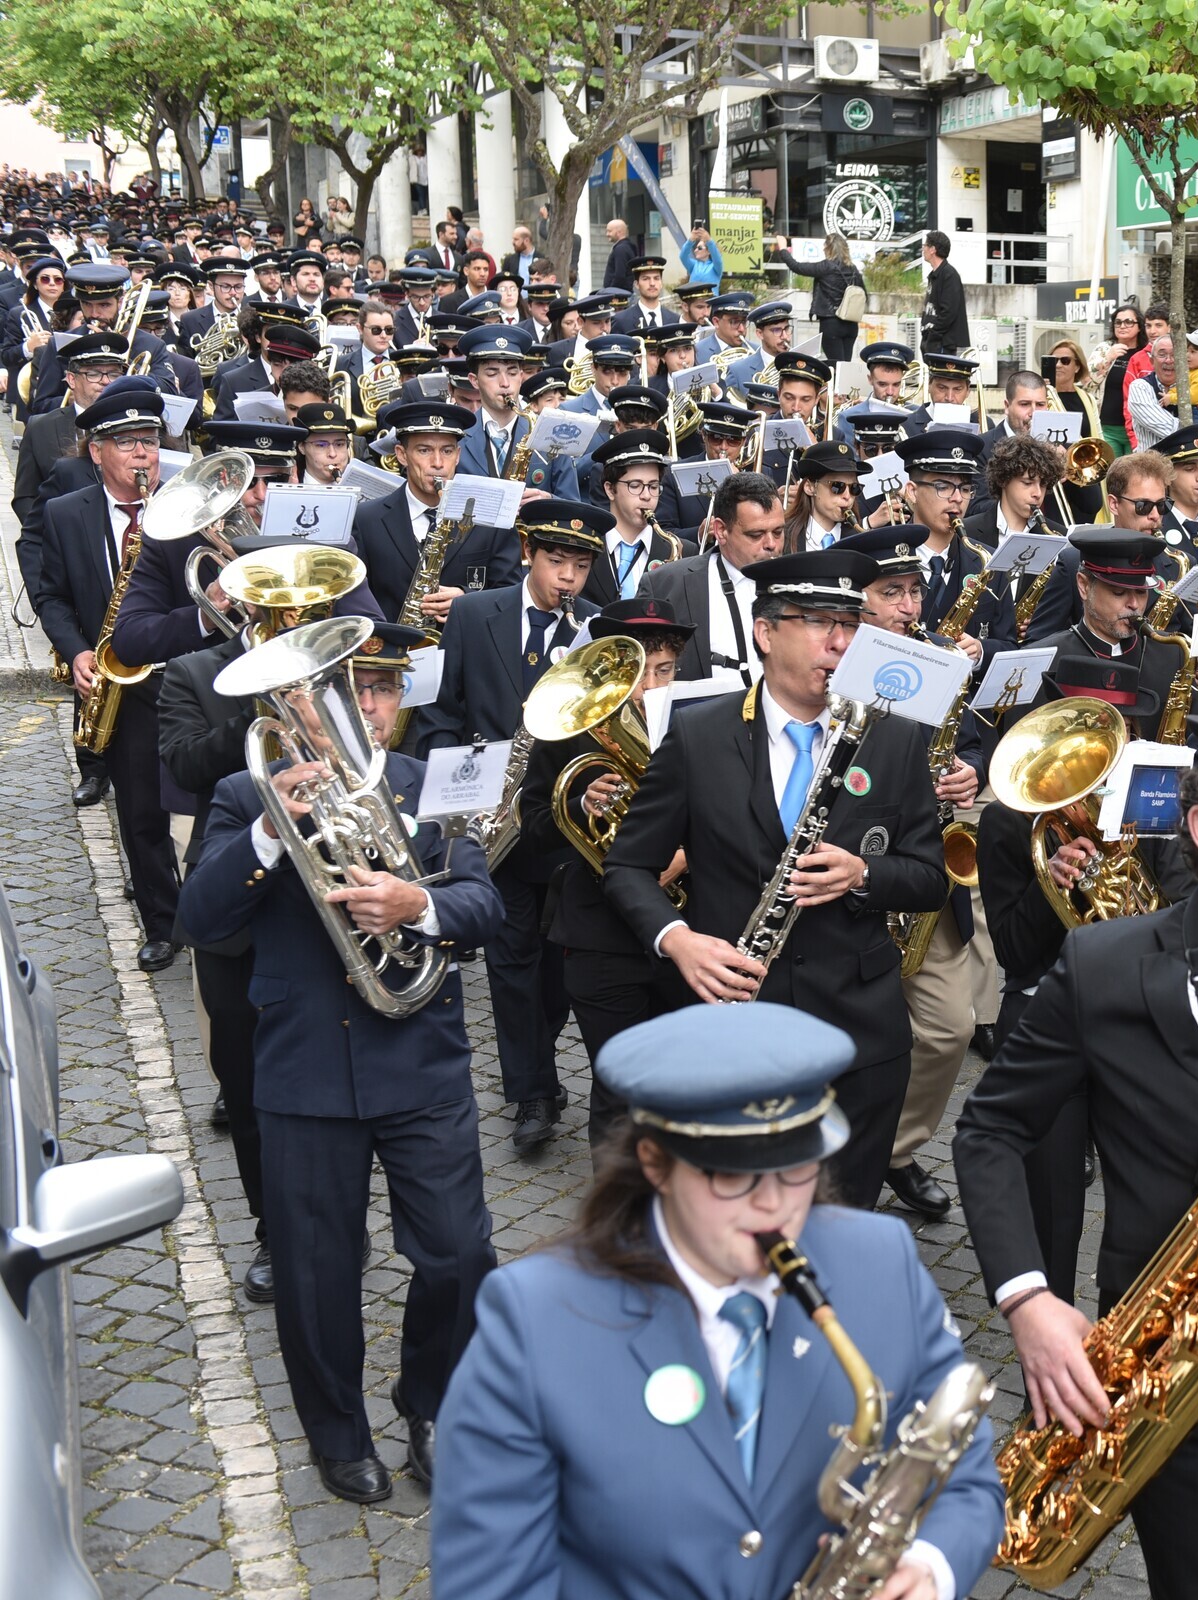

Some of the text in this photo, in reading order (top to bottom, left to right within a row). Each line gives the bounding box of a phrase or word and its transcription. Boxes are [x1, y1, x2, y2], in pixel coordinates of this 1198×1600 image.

[713, 101, 751, 128] CNABIS
[836, 163, 879, 176] LEIRIA
[837, 218, 881, 228] CANNABIS
[715, 226, 756, 241] manjar
[873, 638, 911, 656] Filarmónica
[1140, 790, 1154, 798] Banda
